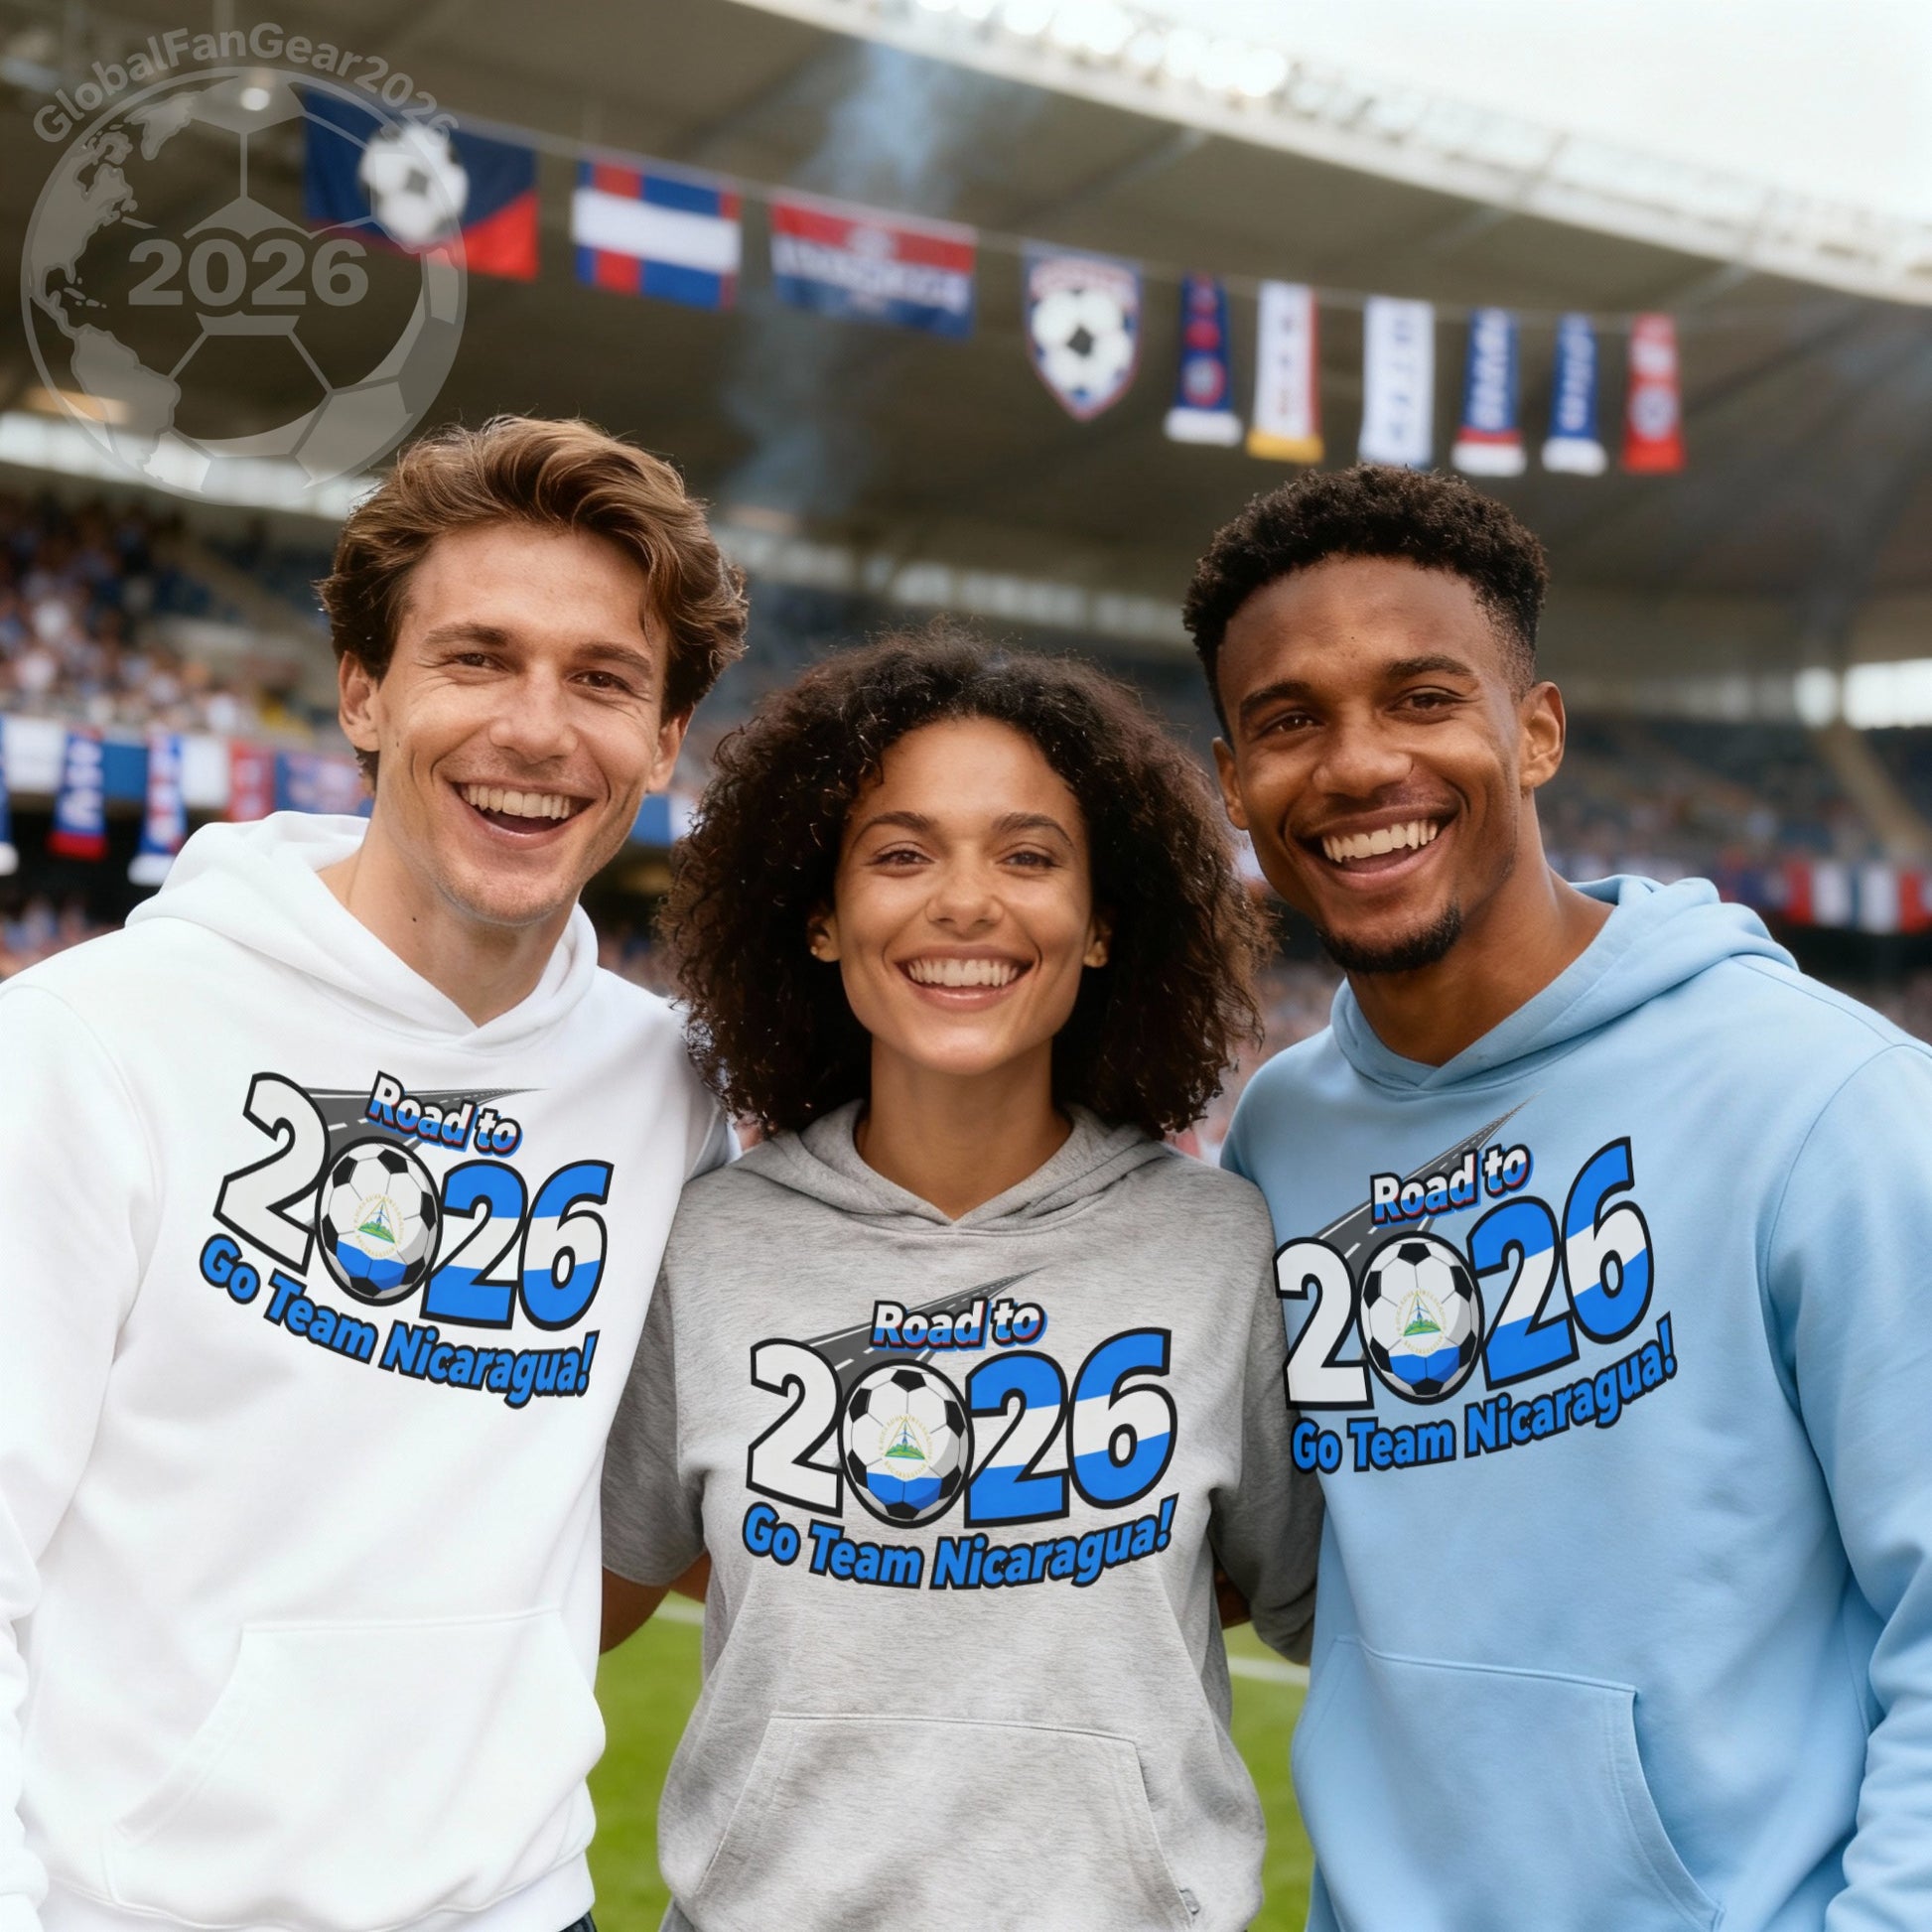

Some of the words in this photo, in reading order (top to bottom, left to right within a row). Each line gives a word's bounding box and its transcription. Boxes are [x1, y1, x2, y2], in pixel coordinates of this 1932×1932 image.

[365, 1070, 475, 1150] Road
[474, 1108, 522, 1157] to
[1370, 1148, 1481, 1228] Road
[1482, 1144, 1534, 1199] to
[212, 1072, 615, 1330] 2026
[1273, 1136, 1654, 1410] 2026
[200, 1233, 260, 1305] Go
[263, 1268, 378, 1364] Team
[378, 1319, 600, 1409] Nicaragua!
[870, 1297, 990, 1350] Road
[991, 1299, 1047, 1344] to
[1291, 1417, 1342, 1474] Go
[1347, 1417, 1456, 1472] Team
[1464, 1311, 1677, 1458] Nicaragua!
[746, 1326, 1177, 1529] 2026
[742, 1501, 800, 1565] Go
[809, 1519, 924, 1588] Team
[930, 1492, 1179, 1589] Nicaragua!
